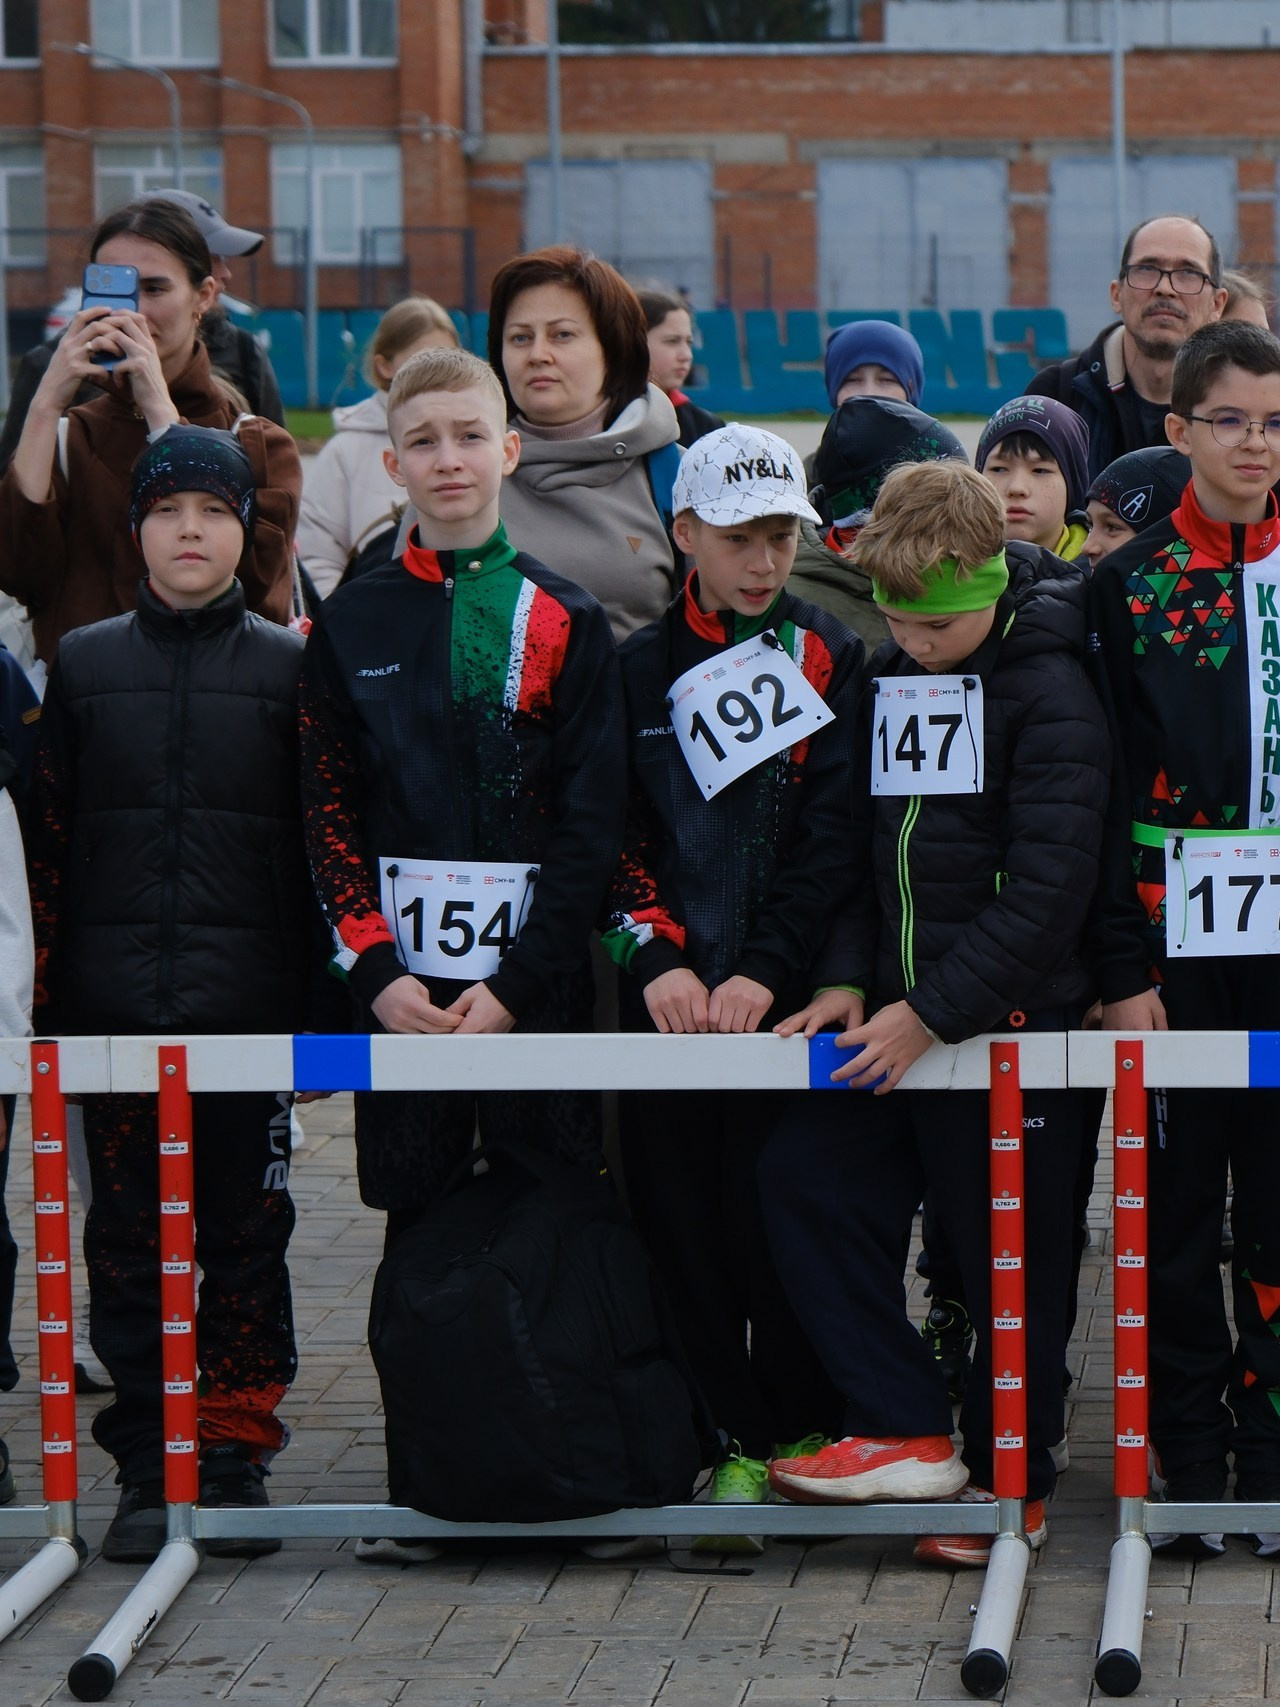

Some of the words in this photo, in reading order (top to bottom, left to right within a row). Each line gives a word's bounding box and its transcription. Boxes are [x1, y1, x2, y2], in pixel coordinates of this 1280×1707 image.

[724, 458, 795, 485] NY&LA
[356, 663, 401, 677] FANLIFE
[637, 726, 675, 737] FANLIF
[689, 673, 804, 763] 192
[878, 713, 963, 773] 147
[401, 897, 519, 958] 154
[1021, 1117, 1046, 1129] SICS
